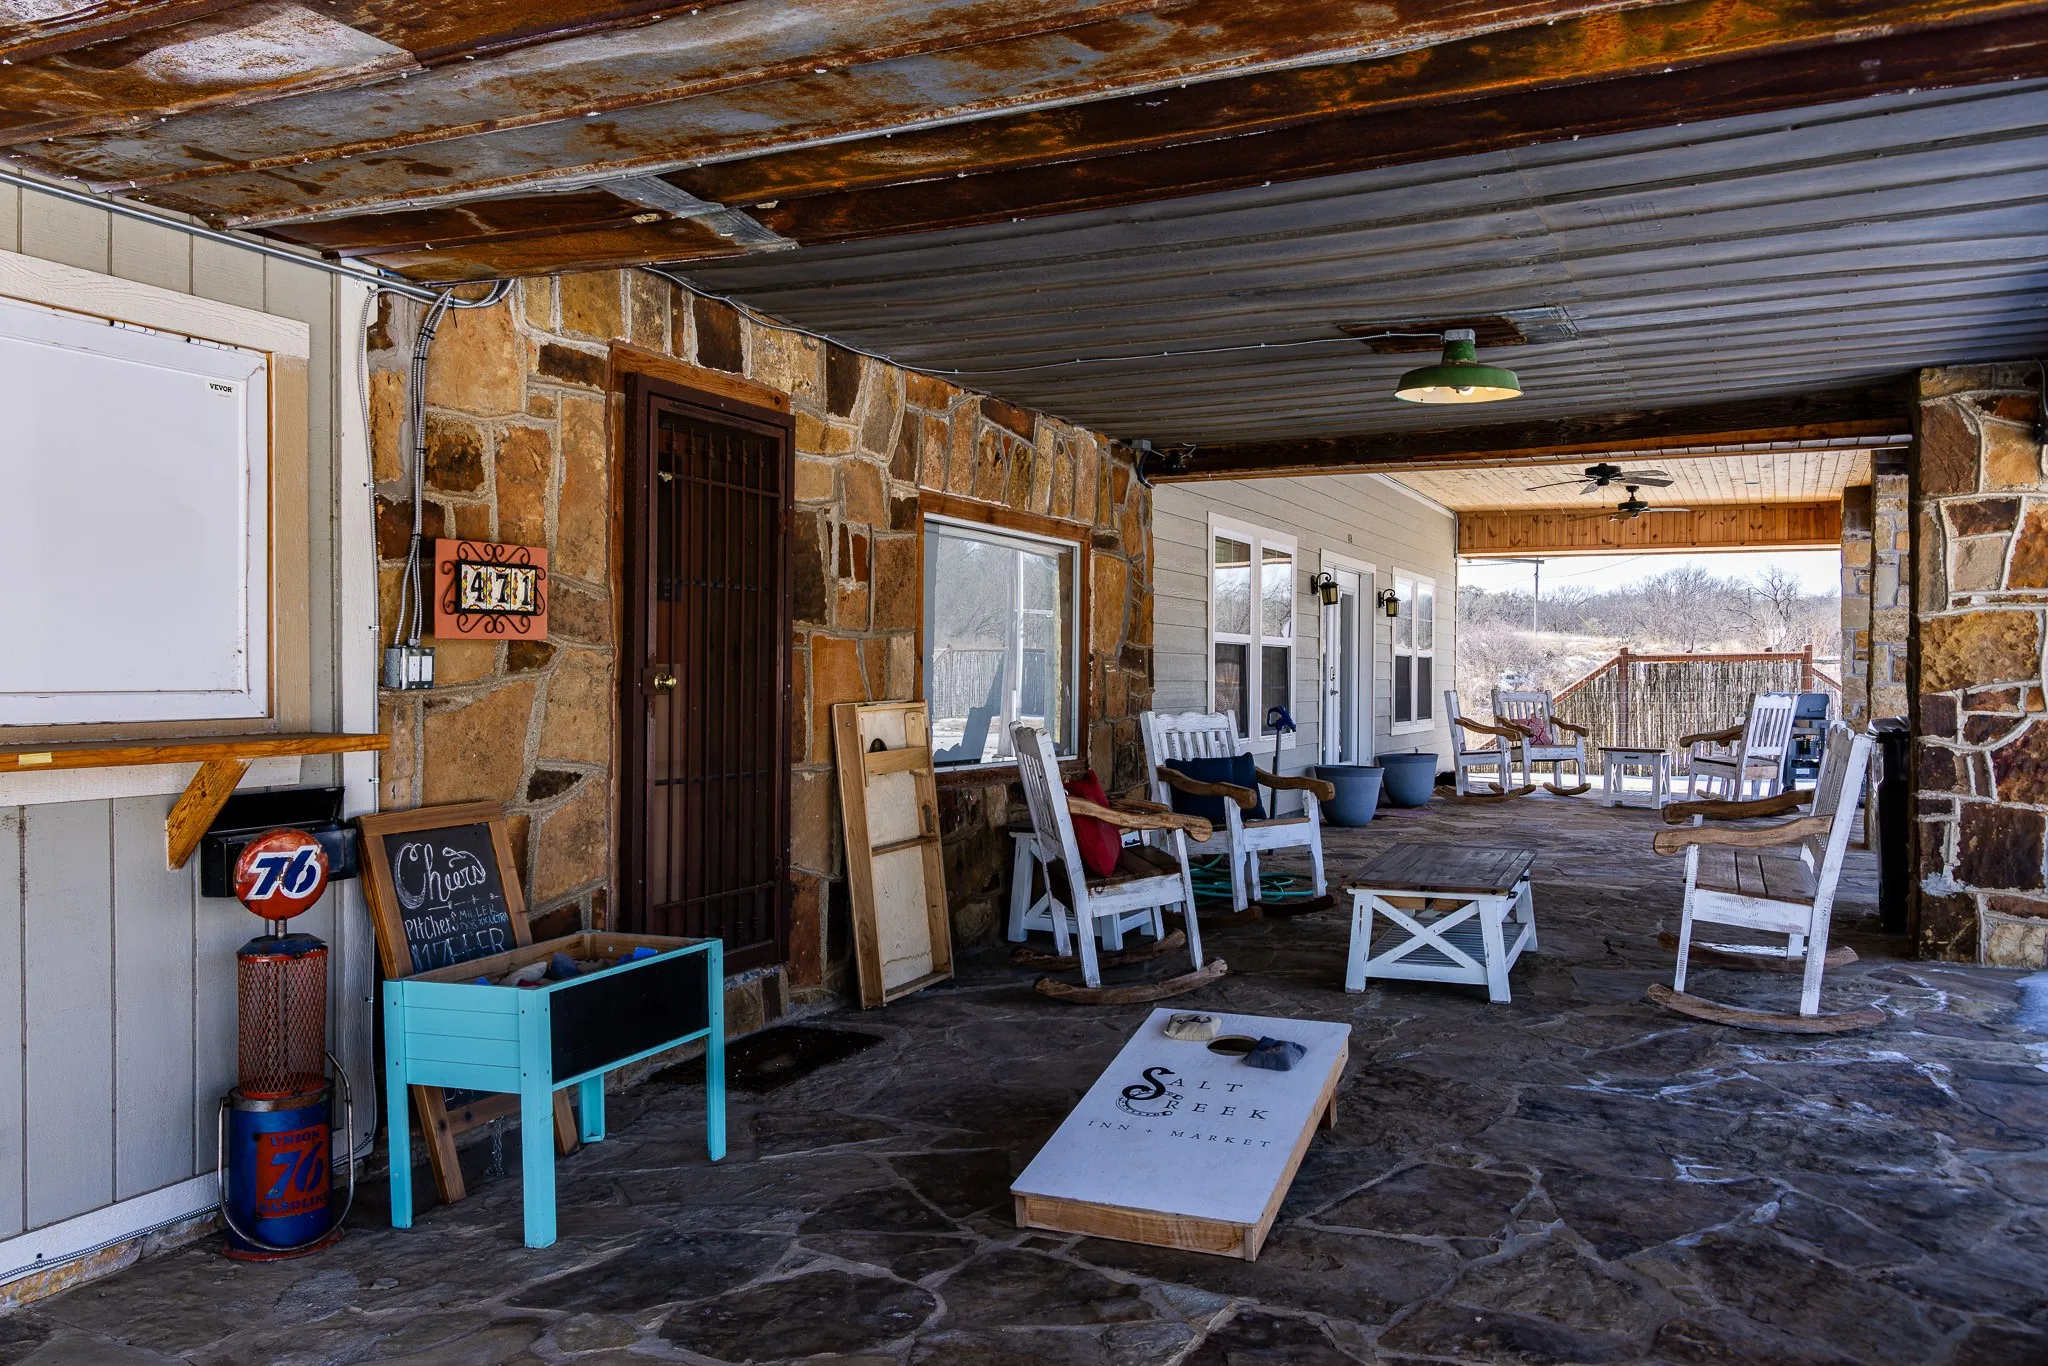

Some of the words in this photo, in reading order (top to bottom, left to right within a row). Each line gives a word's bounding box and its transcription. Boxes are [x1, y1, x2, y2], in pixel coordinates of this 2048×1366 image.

[209, 383, 232, 393] VEVOR
[470, 571, 531, 605] 471
[246, 846, 320, 899] 76
[395, 842, 486, 909] Cheers
[1122, 1066, 1243, 1101] SALT
[270, 1129, 321, 1147] UNION
[1088, 1120, 1131, 1131] INN
[1170, 1130, 1272, 1148] MARKET
[266, 1141, 324, 1200] 76
